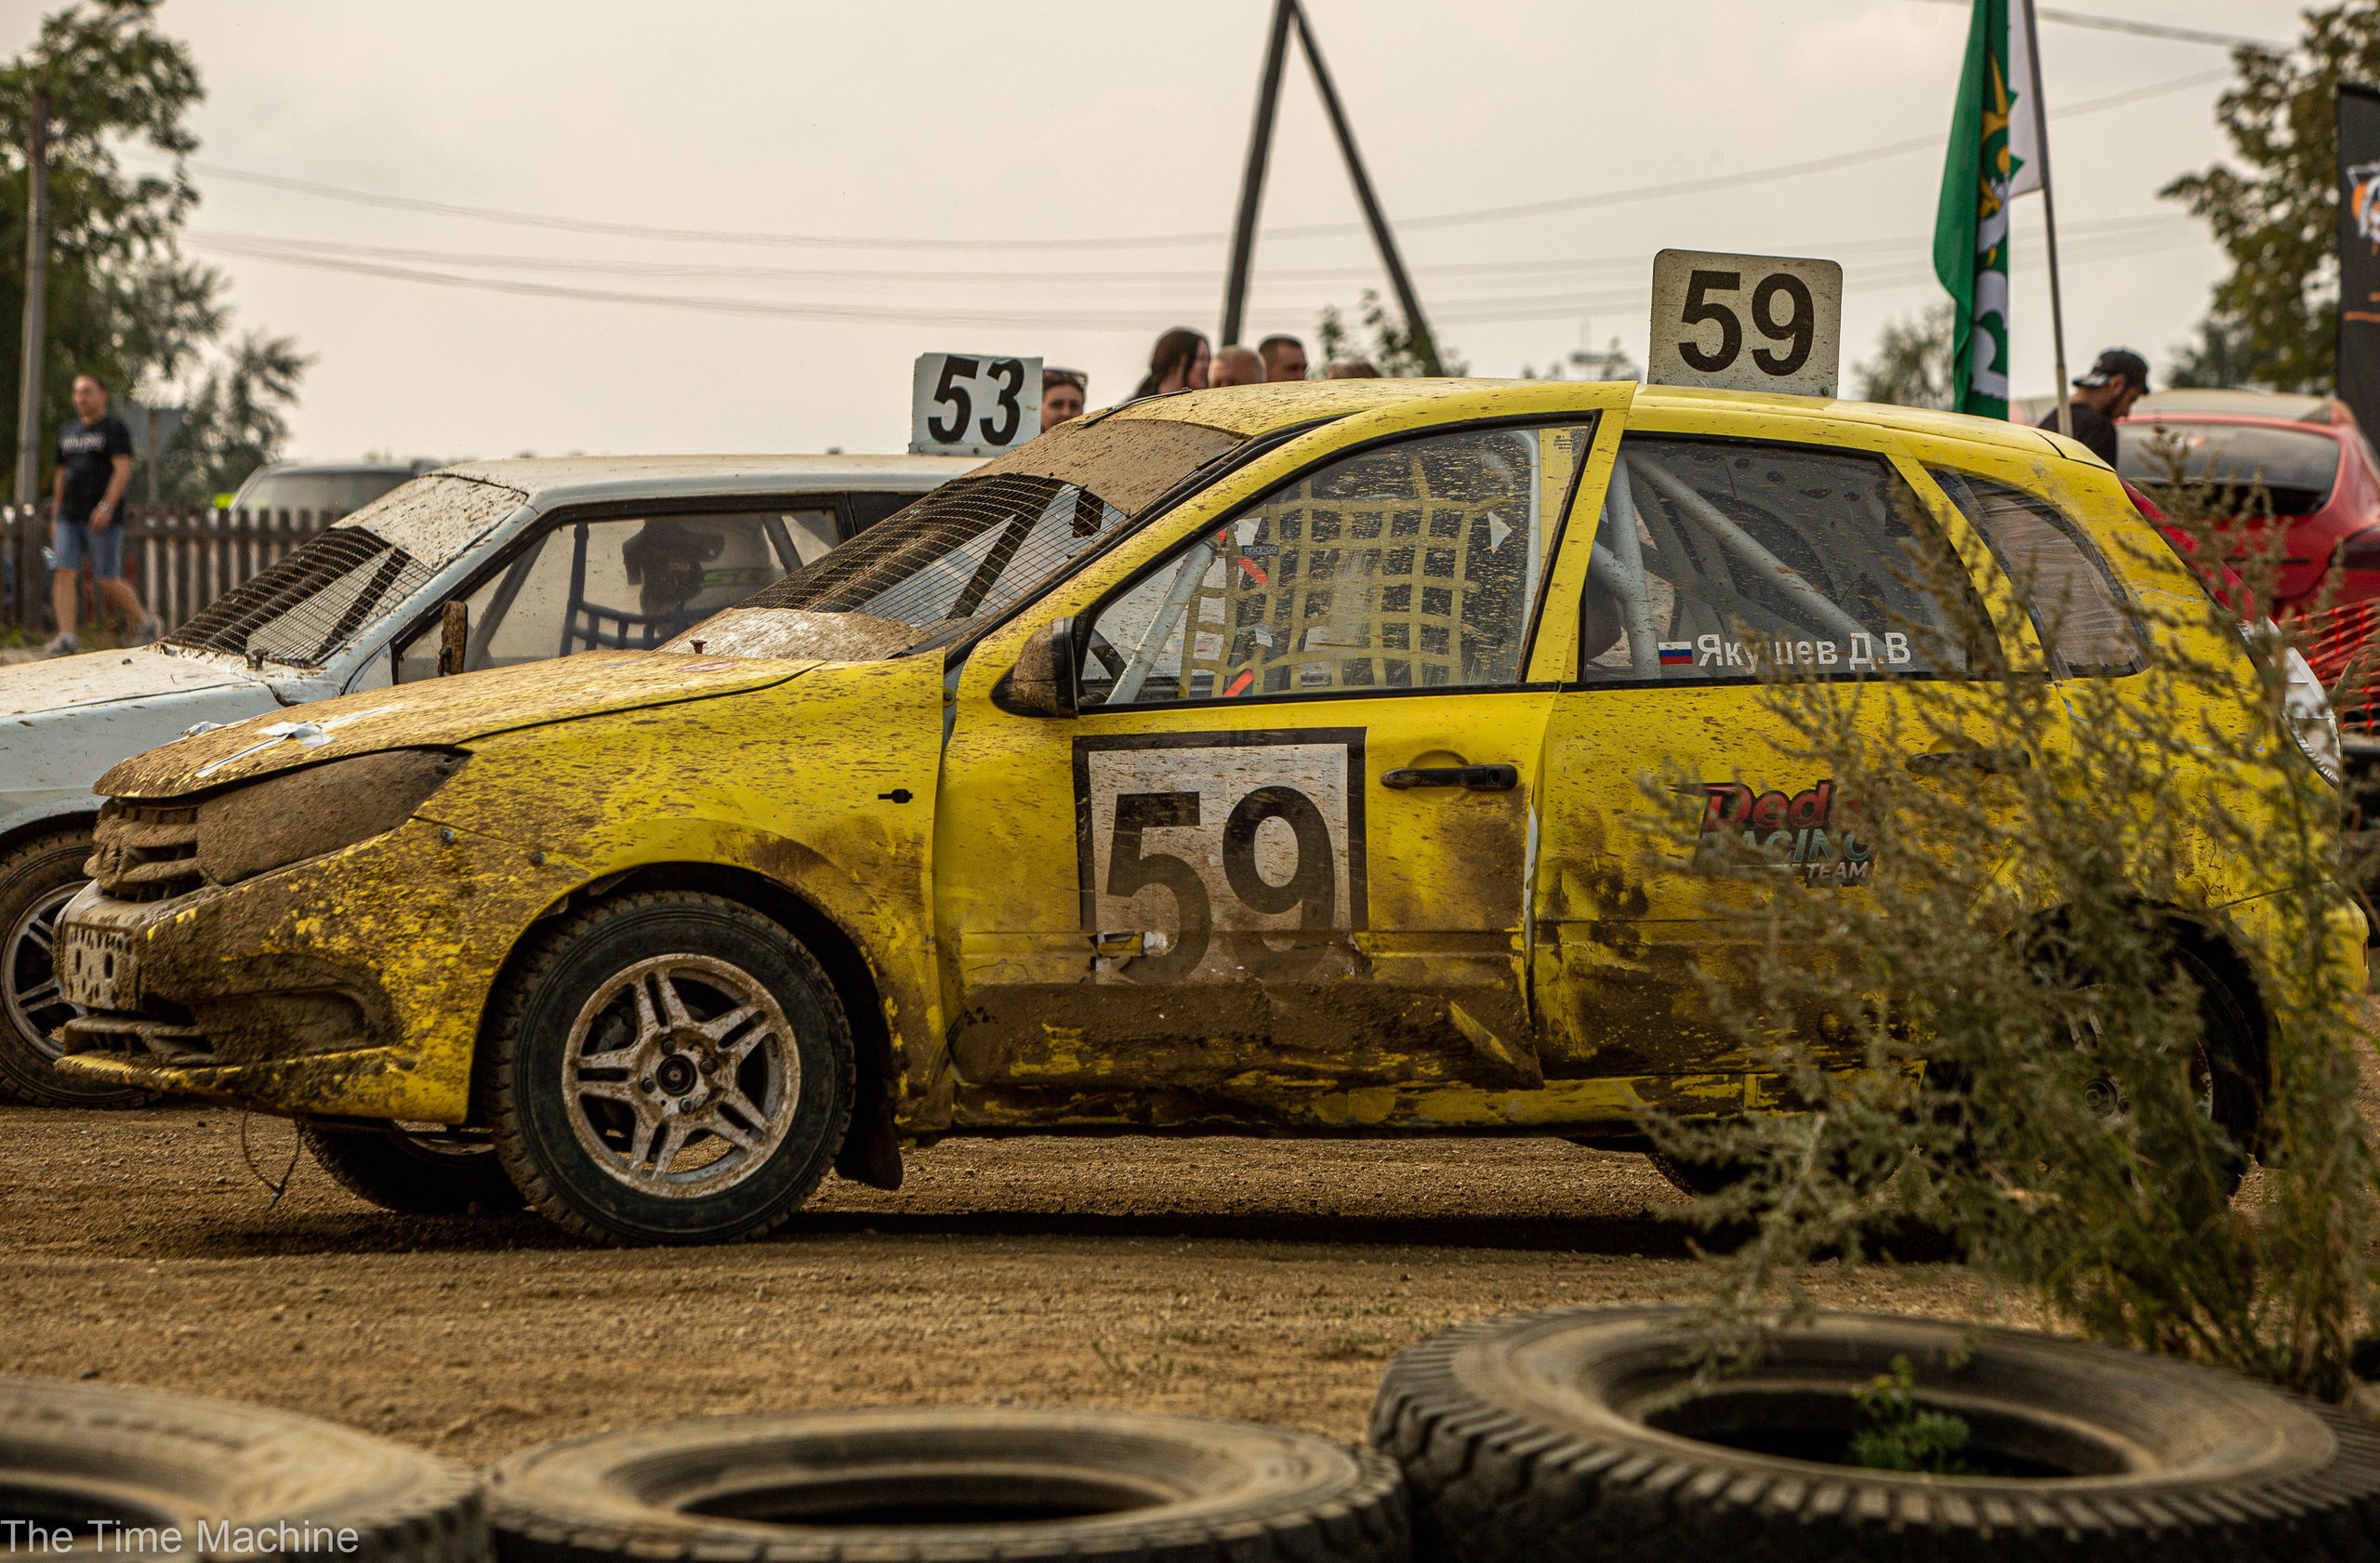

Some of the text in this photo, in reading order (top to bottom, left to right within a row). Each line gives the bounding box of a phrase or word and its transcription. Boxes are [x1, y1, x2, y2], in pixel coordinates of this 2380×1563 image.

[1678, 270, 1815, 377] 59
[928, 354, 1025, 446] 53
[1106, 785, 1336, 984] 59
[1806, 861, 1870, 880] TEAM
